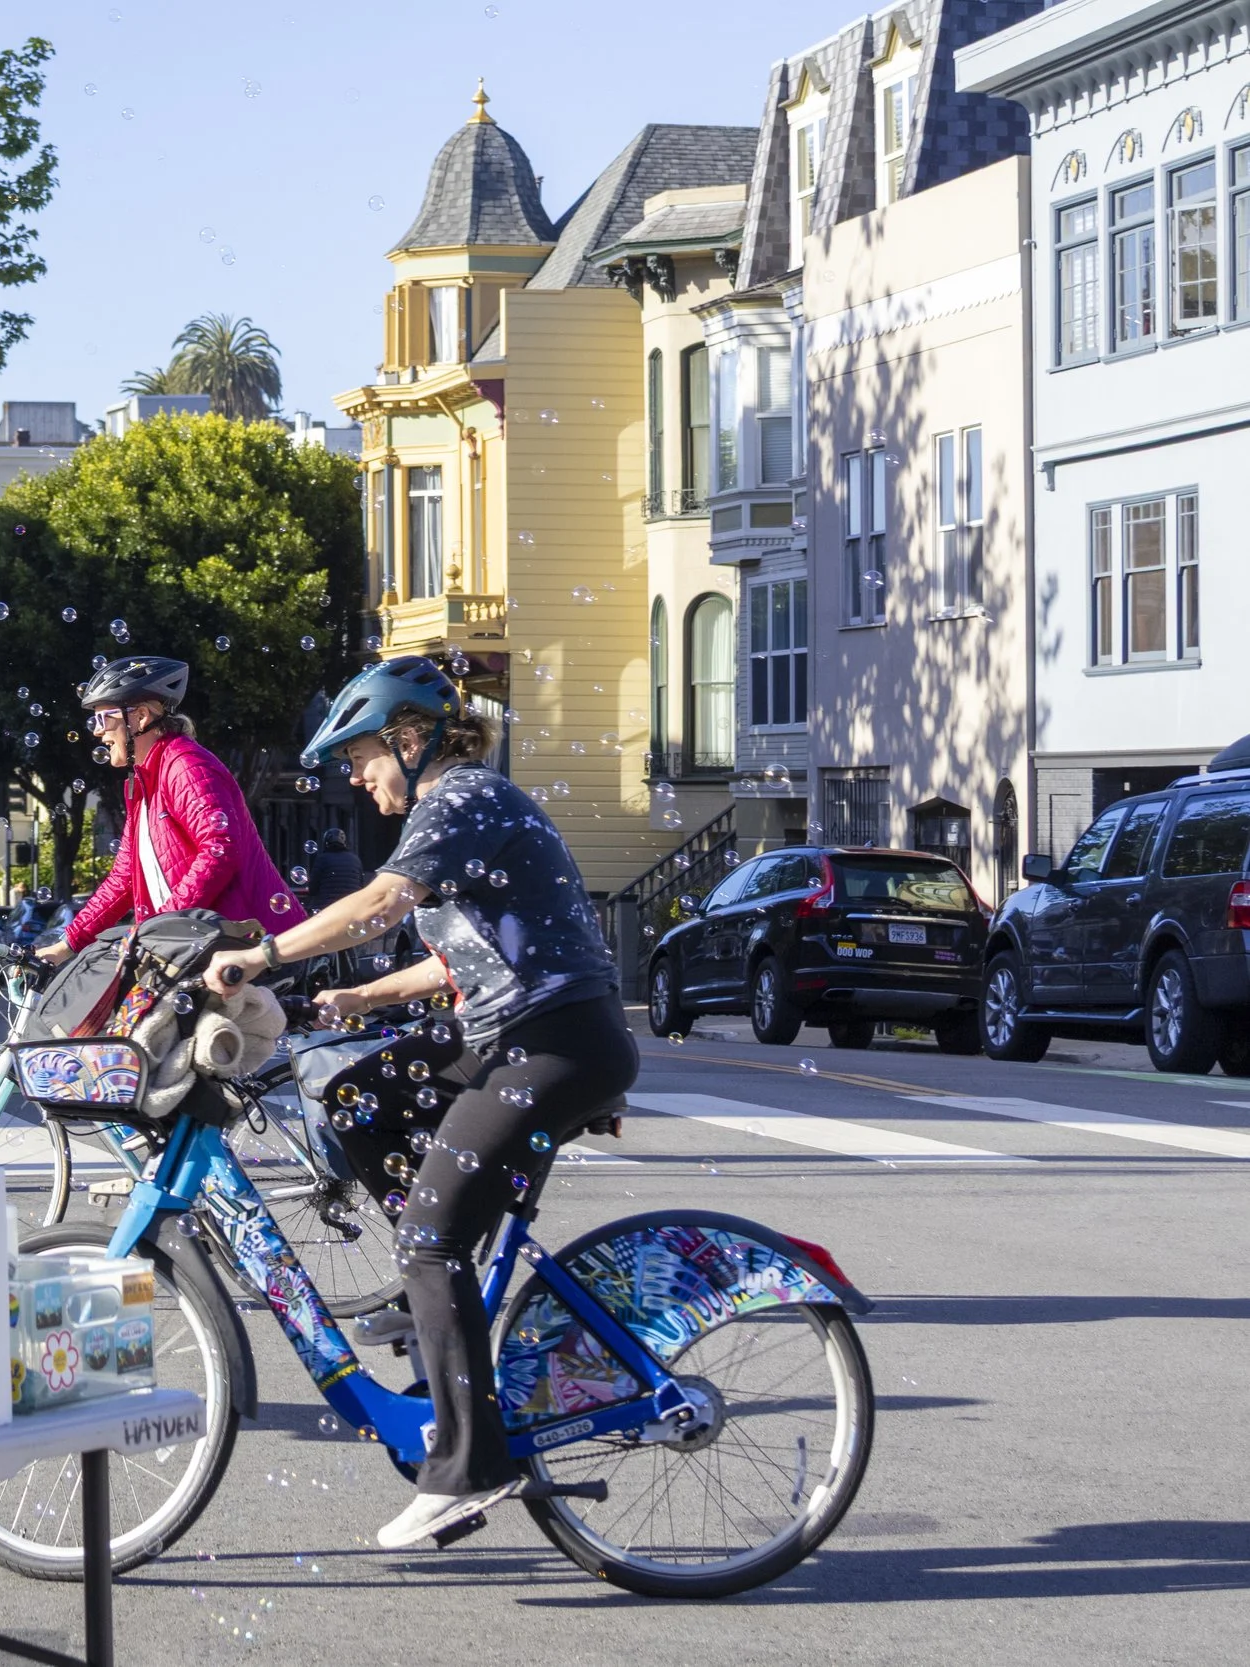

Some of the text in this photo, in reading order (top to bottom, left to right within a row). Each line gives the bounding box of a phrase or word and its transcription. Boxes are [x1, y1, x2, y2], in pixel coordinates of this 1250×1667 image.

[855, 948, 874, 959] WOP
[245, 1217, 271, 1252] bay
[265, 1255, 303, 1311] wheels
[738, 1266, 783, 1296] lyft
[537, 1421, 590, 1446] 840-1226
